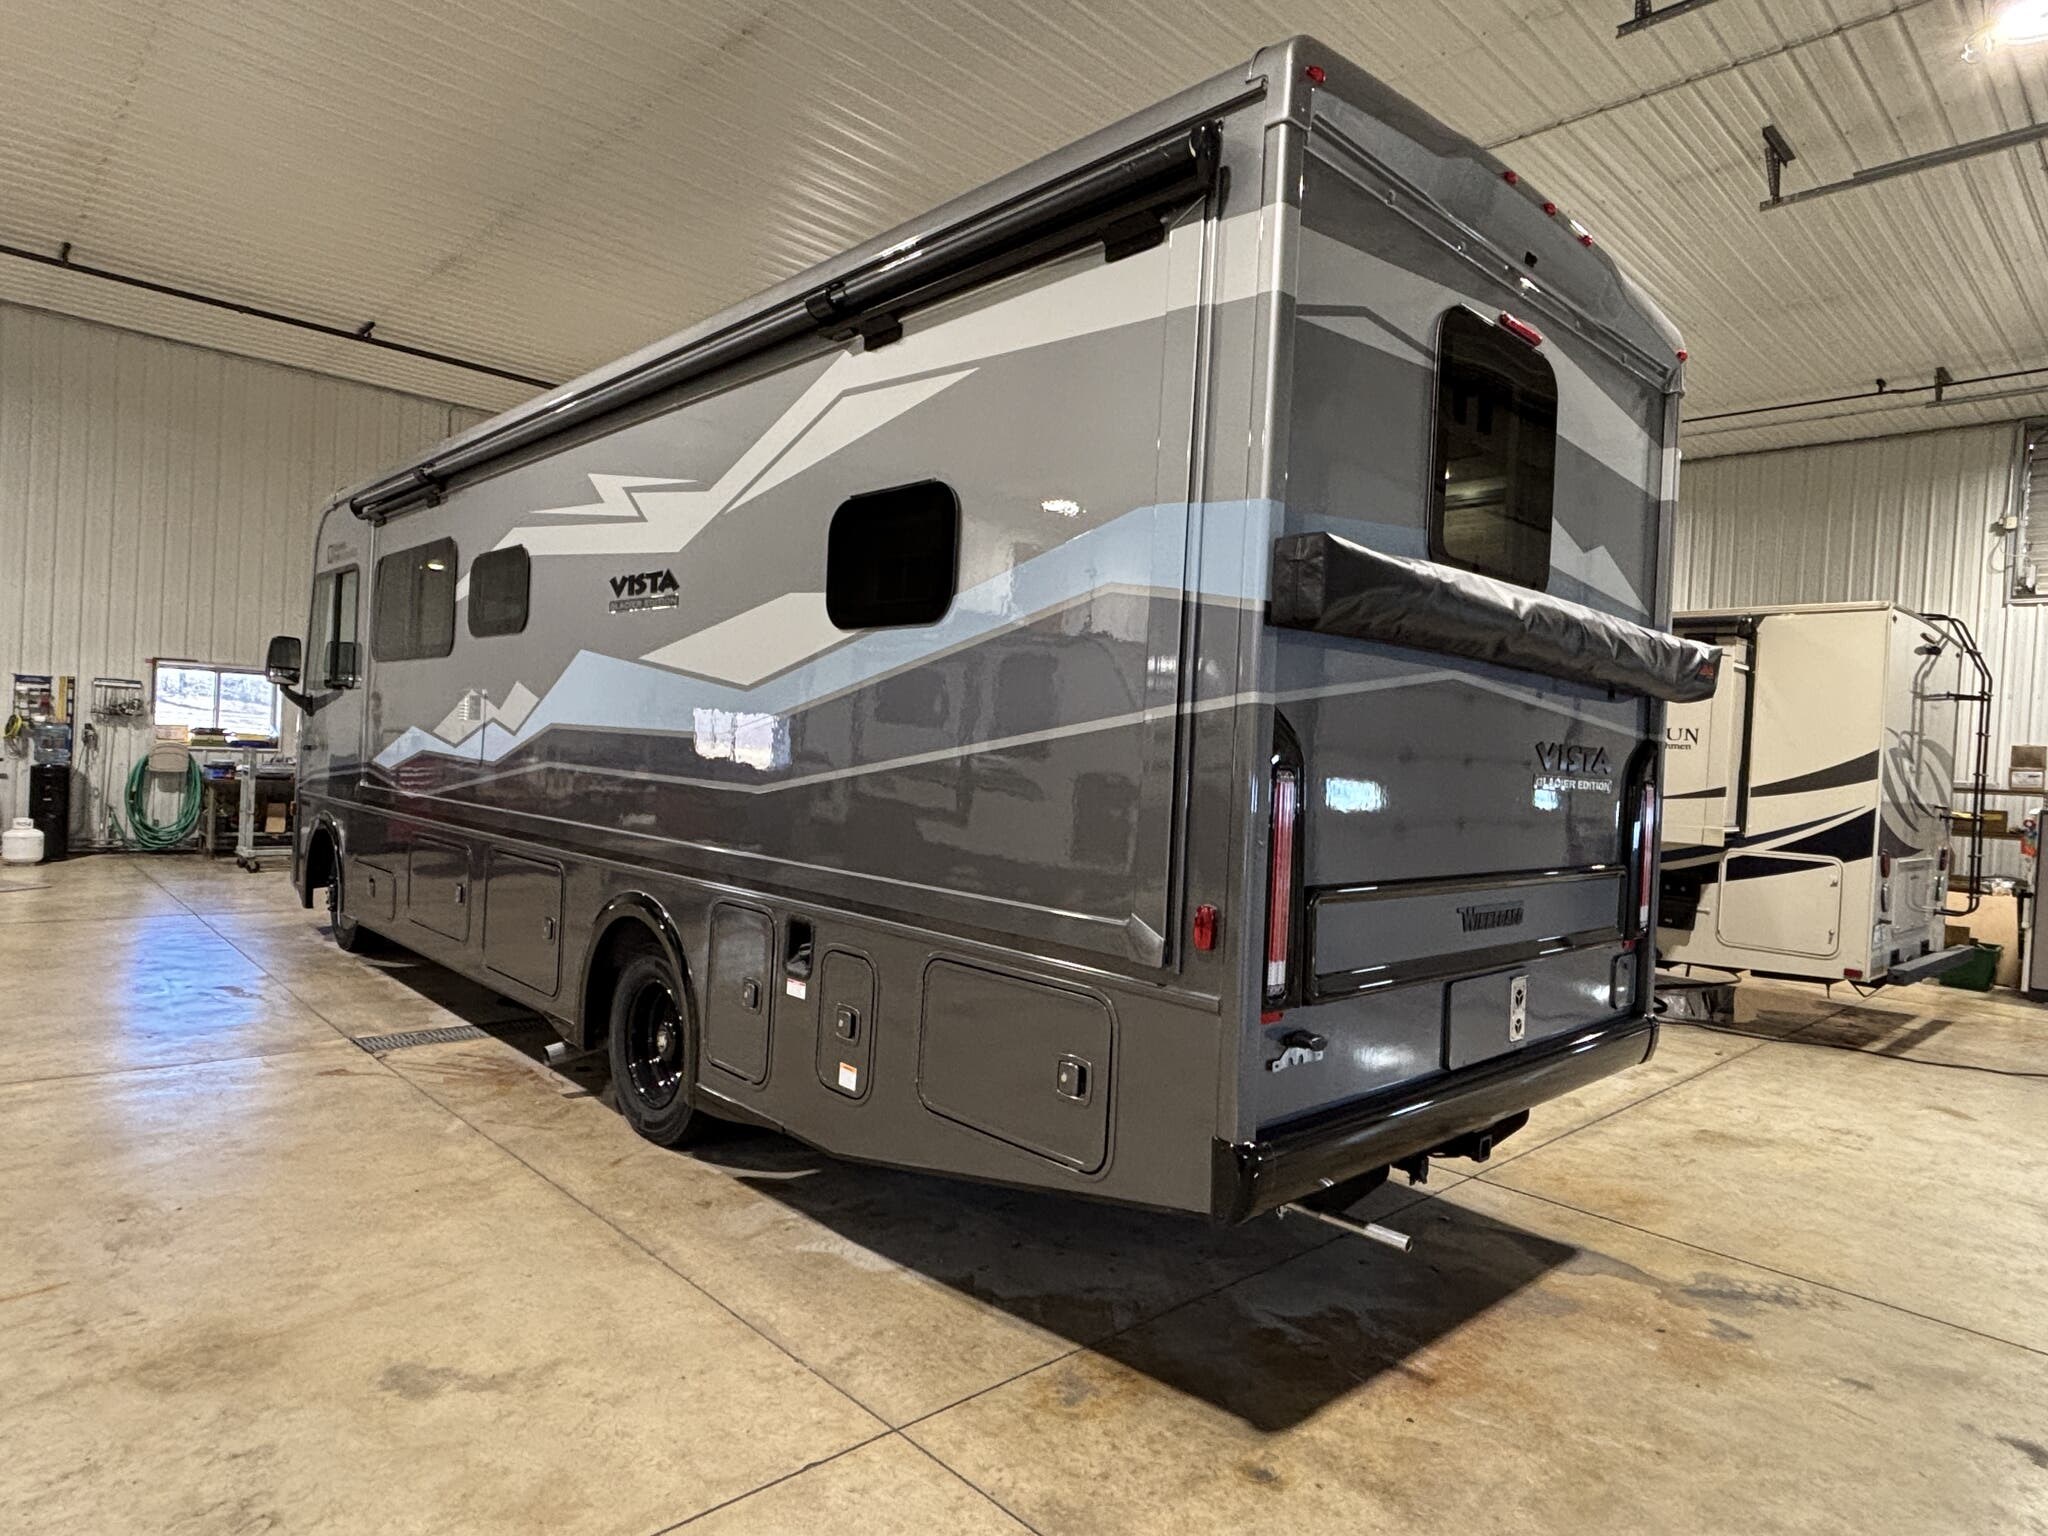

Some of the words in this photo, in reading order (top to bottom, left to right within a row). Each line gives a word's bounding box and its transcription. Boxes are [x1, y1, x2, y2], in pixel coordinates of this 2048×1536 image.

[609, 568, 680, 598] VISTA
[1535, 741, 1610, 775] VISTA
[1535, 777, 1577, 790] GLACIER
[1578, 780, 1610, 792] EDITION
